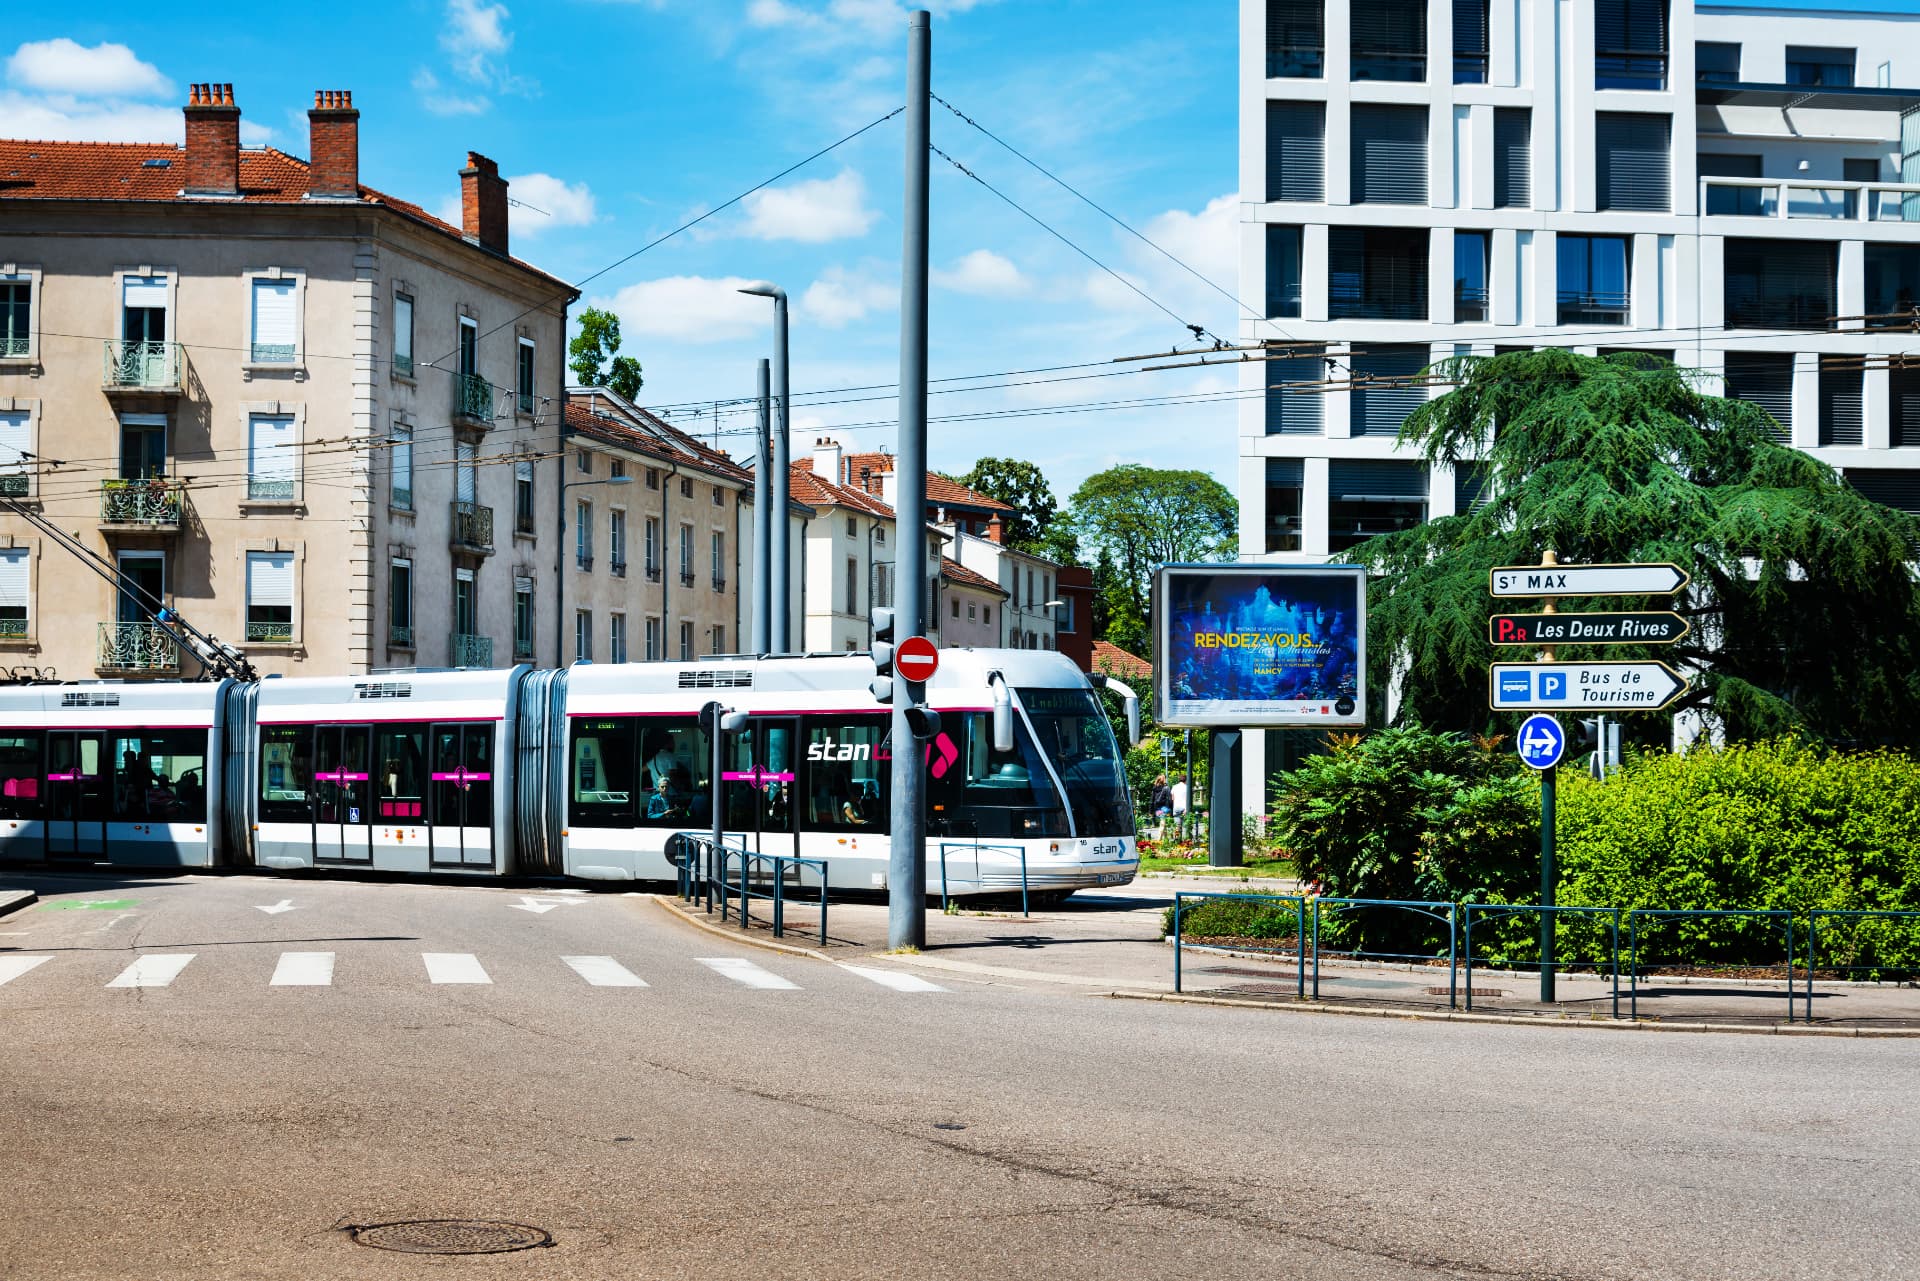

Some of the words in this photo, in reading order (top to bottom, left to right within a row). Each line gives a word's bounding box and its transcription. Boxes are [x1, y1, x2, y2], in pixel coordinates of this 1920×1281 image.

[1528, 574, 1567, 589] MAX
[1498, 618, 1527, 641] P+R
[1535, 621, 1565, 638] Les
[1569, 620, 1616, 638] Deux
[1620, 619, 1670, 637] Rives
[1253, 667, 1283, 675] NANCY
[1579, 671, 1610, 684] Bus
[1621, 670, 1641, 684] de
[1545, 677, 1559, 696] P
[1581, 688, 1655, 701] Tourisme
[1093, 843, 1117, 855] stan
